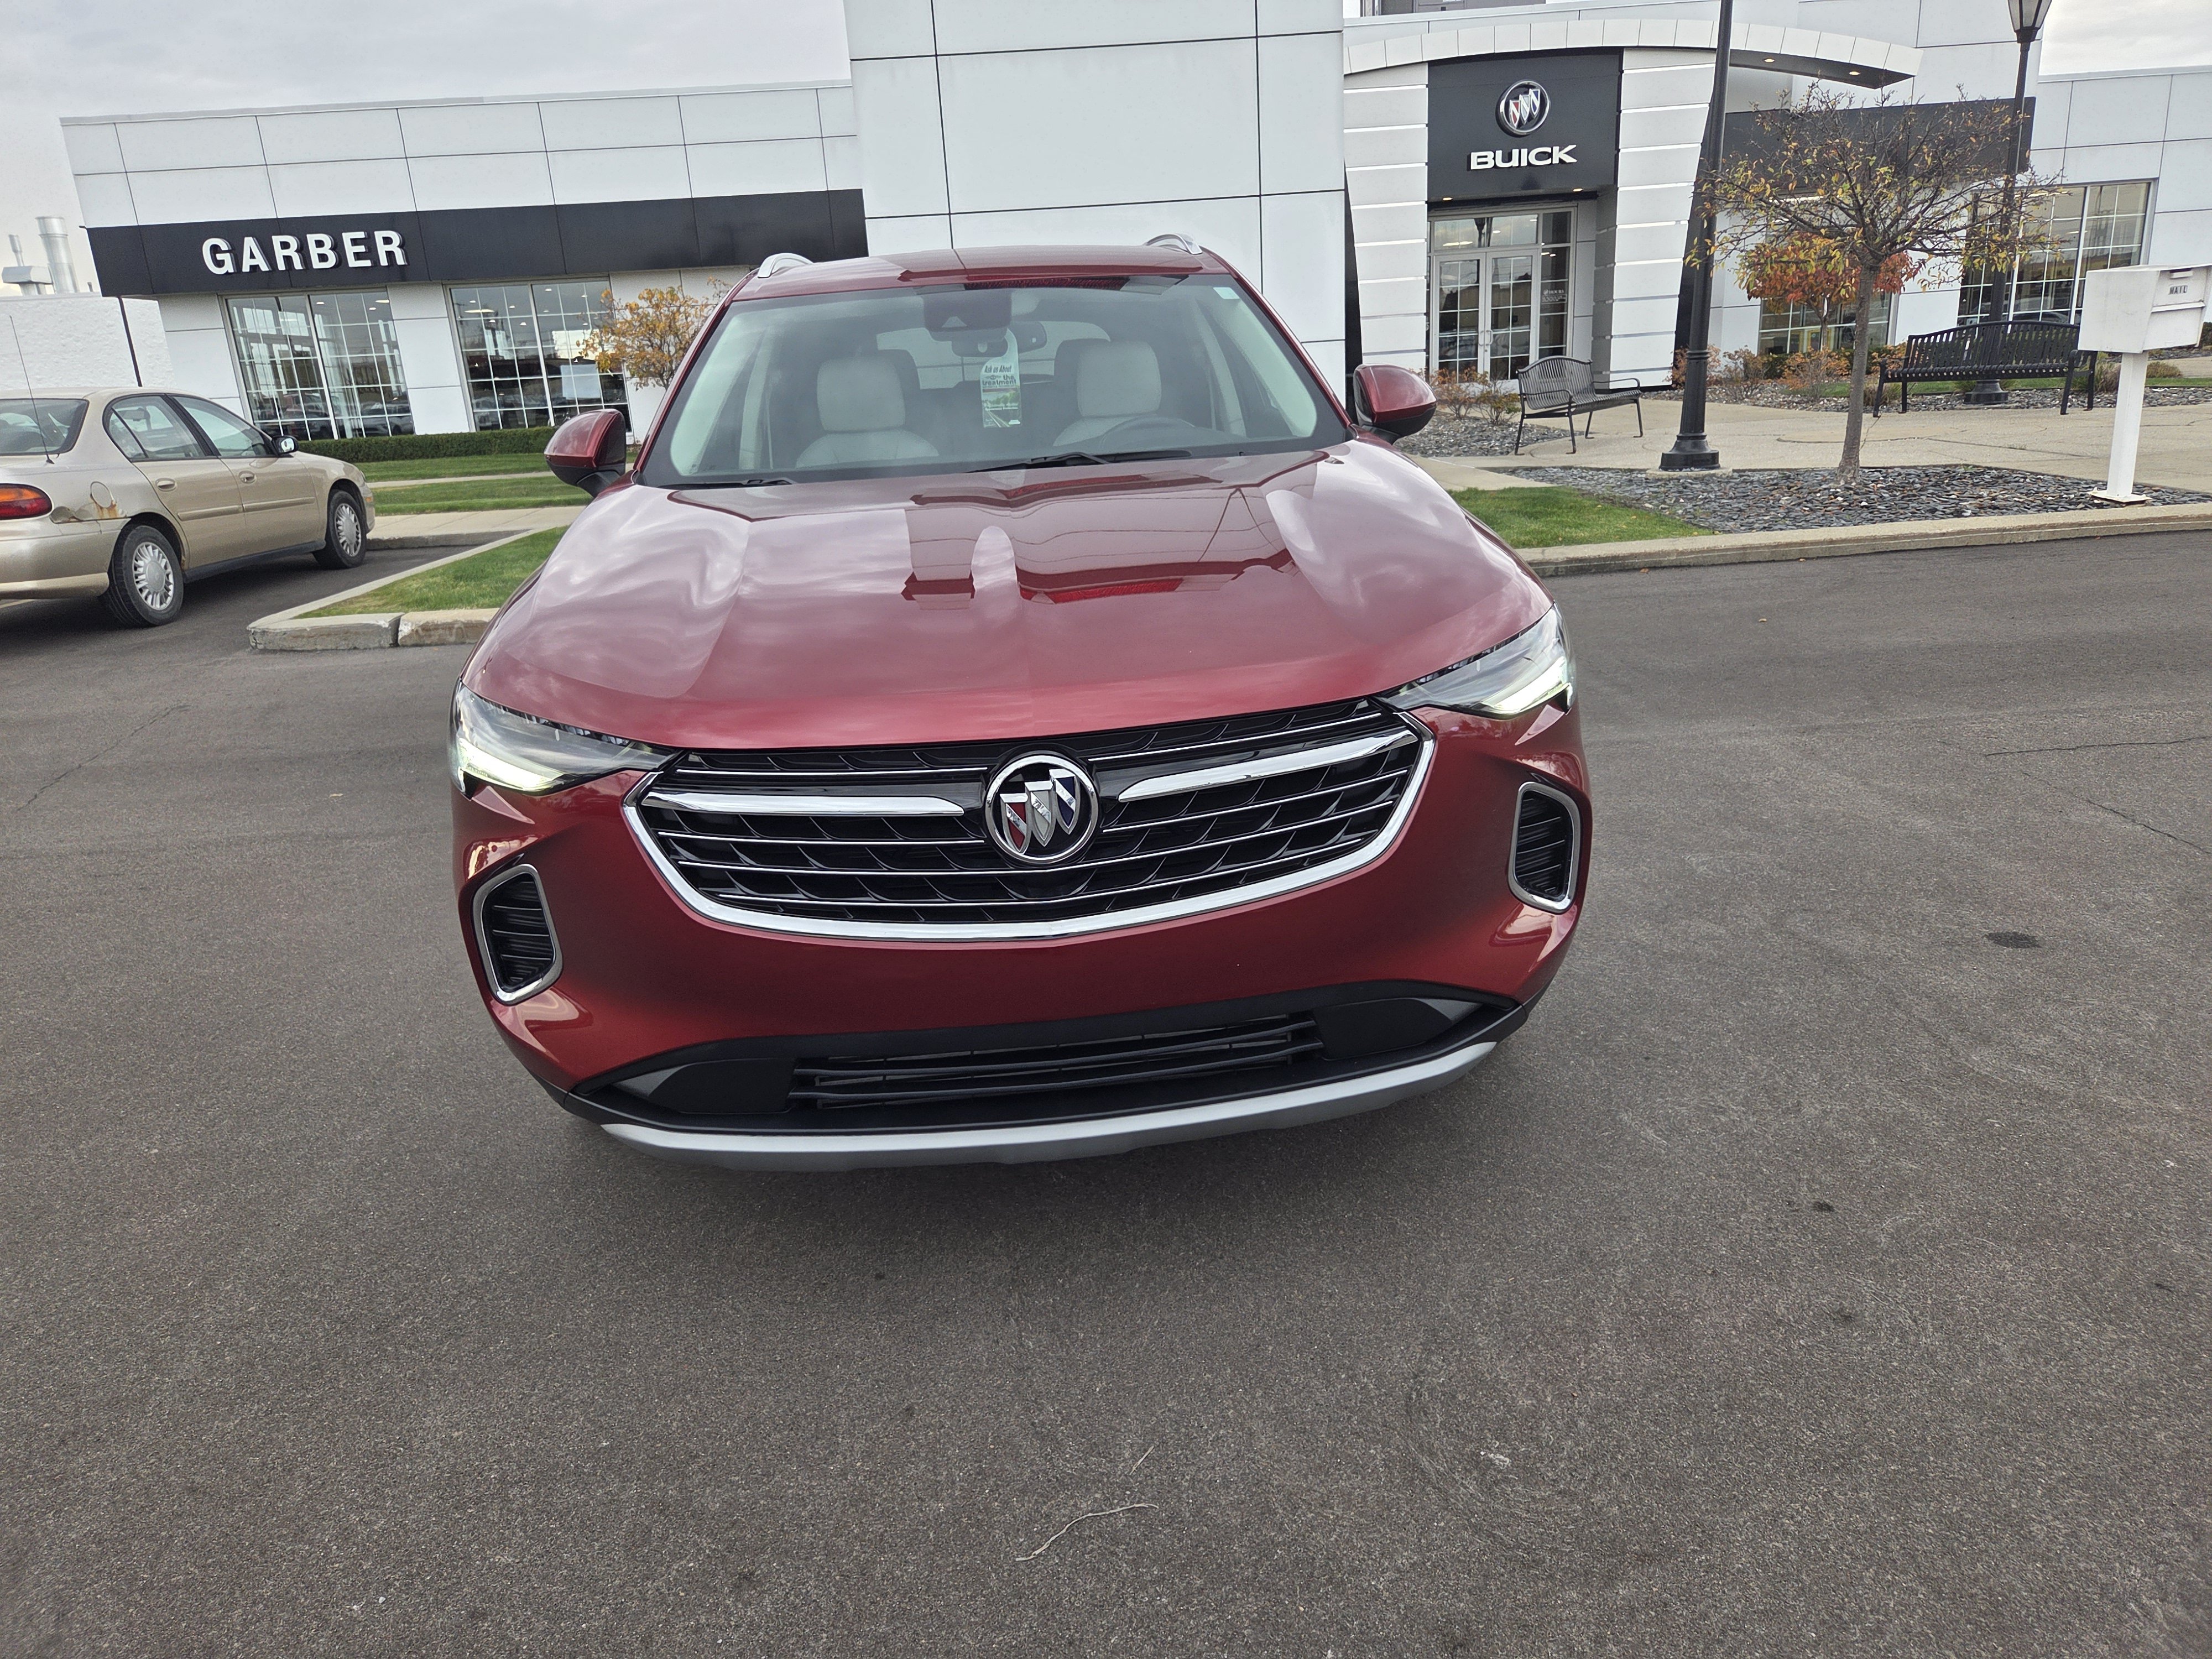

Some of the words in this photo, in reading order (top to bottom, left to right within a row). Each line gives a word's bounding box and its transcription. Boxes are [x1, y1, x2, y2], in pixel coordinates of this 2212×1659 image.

[1470, 144, 1578, 170] BUICK
[202, 230, 408, 275] GARBER
[2169, 285, 2188, 294] MAIL
